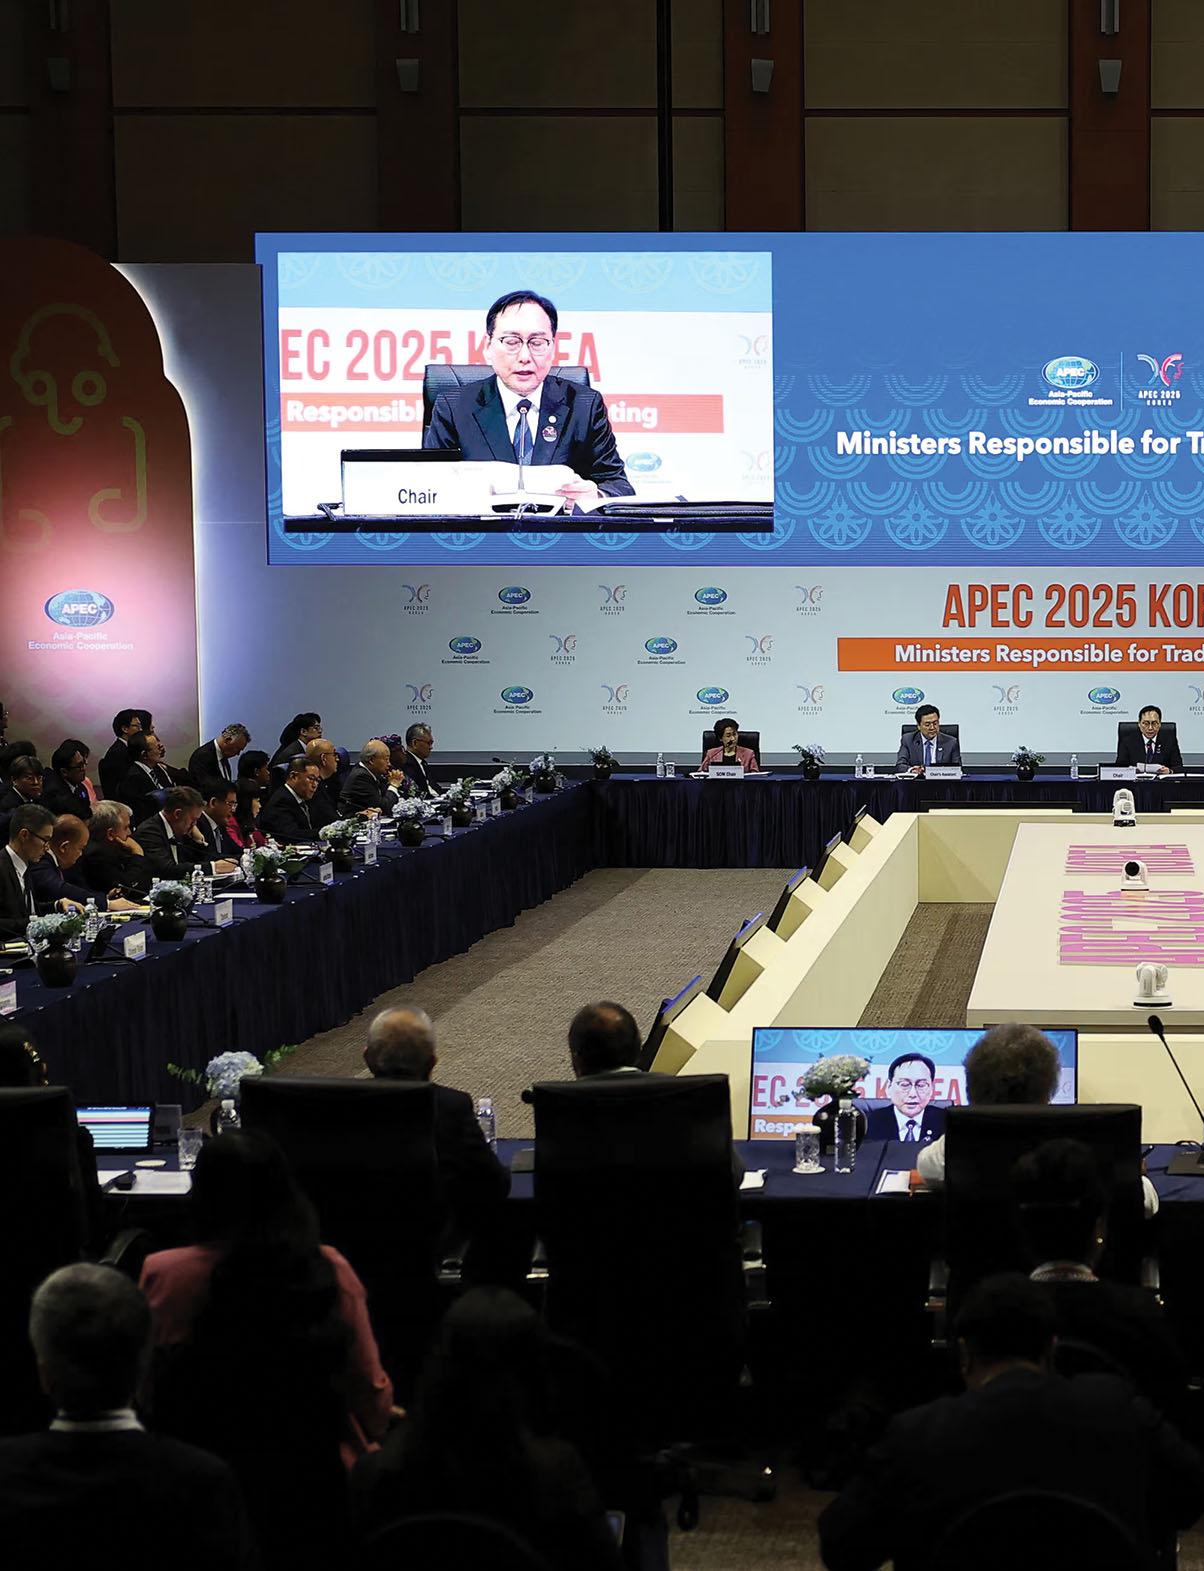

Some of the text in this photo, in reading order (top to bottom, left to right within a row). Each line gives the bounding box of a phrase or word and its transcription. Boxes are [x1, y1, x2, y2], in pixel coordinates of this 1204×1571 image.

[282, 329, 601, 382] EC 2025 KEA
[1056, 367, 1085, 377] APEC
[1028, 398, 1113, 407] Economic Cooperation
[1048, 390, 1093, 398] Asia-Pacific
[1138, 390, 1181, 399] APEC 2025
[287, 400, 423, 428] Responsibl
[608, 402, 657, 428] ting
[837, 431, 961, 455] Ministers
[968, 431, 1135, 461] Responsible
[1141, 431, 1184, 455] for
[398, 488, 438, 505] Chair
[62, 603, 98, 615] APEC
[942, 583, 1033, 628] APEC
[1045, 583, 1136, 628] 2025
[53, 631, 108, 640] Asia-Pacific
[28, 641, 134, 651] Economic Cooperation
[895, 645, 990, 663] Ministers
[997, 644, 1122, 667] Responsible
[1128, 644, 1159, 663] for
[876, 1076, 961, 1106] KEA
